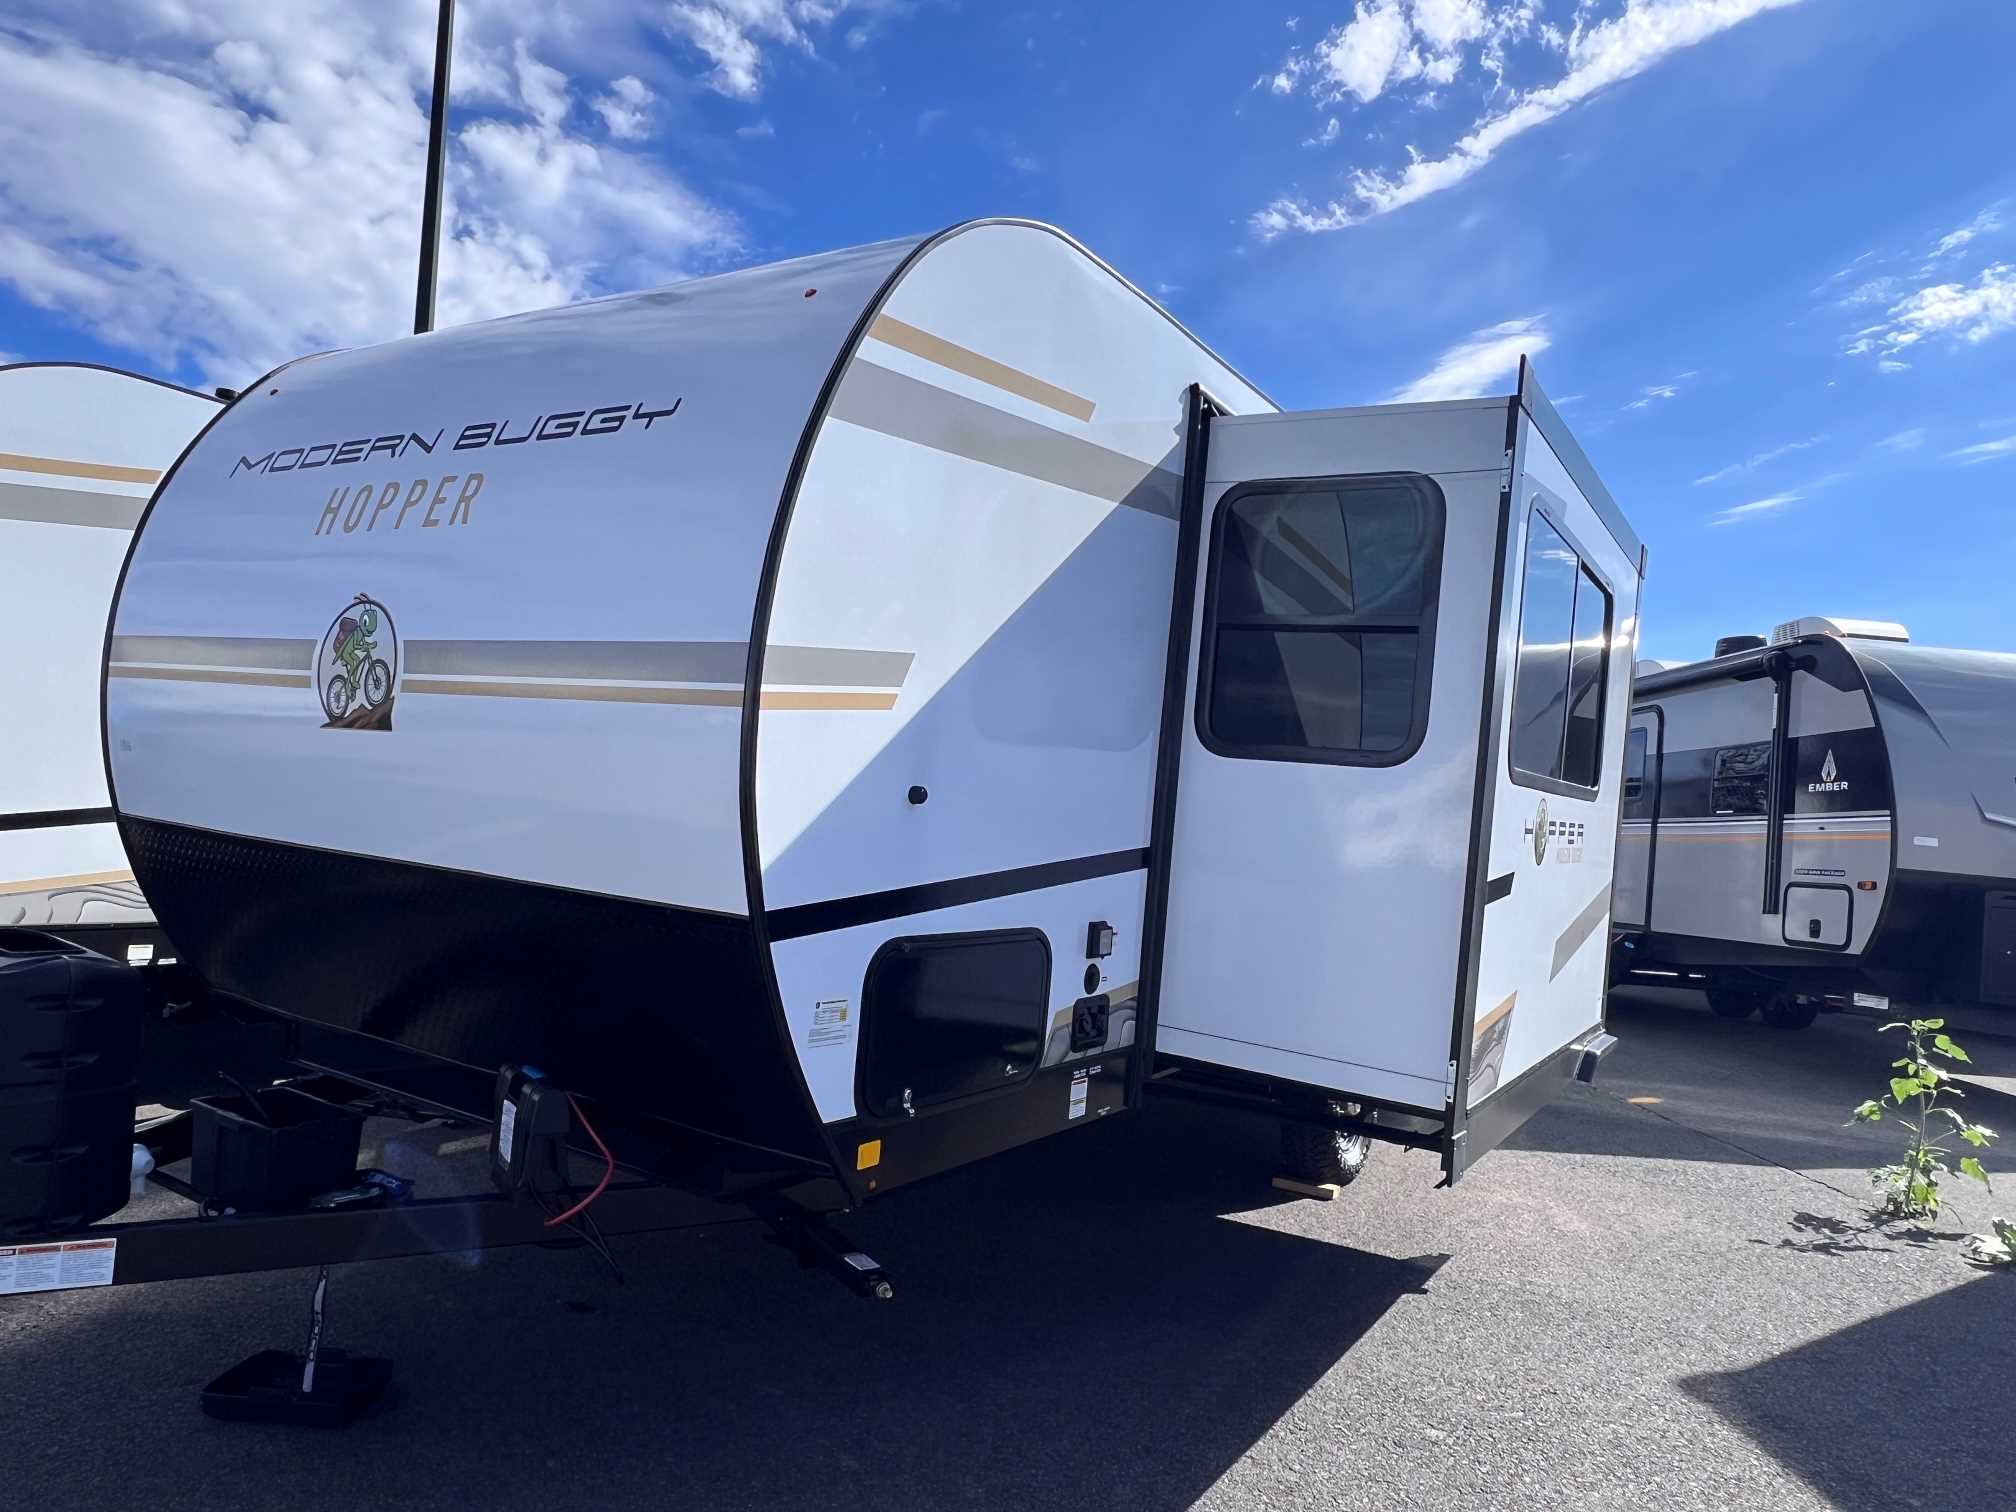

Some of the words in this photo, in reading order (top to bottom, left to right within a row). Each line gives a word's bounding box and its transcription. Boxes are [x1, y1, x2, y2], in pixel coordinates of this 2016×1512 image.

[229, 428, 445, 479] MODERN
[452, 396, 683, 452] BUGGY
[314, 471, 485, 536] HOPPER
[1808, 781, 1849, 792] EMBER
